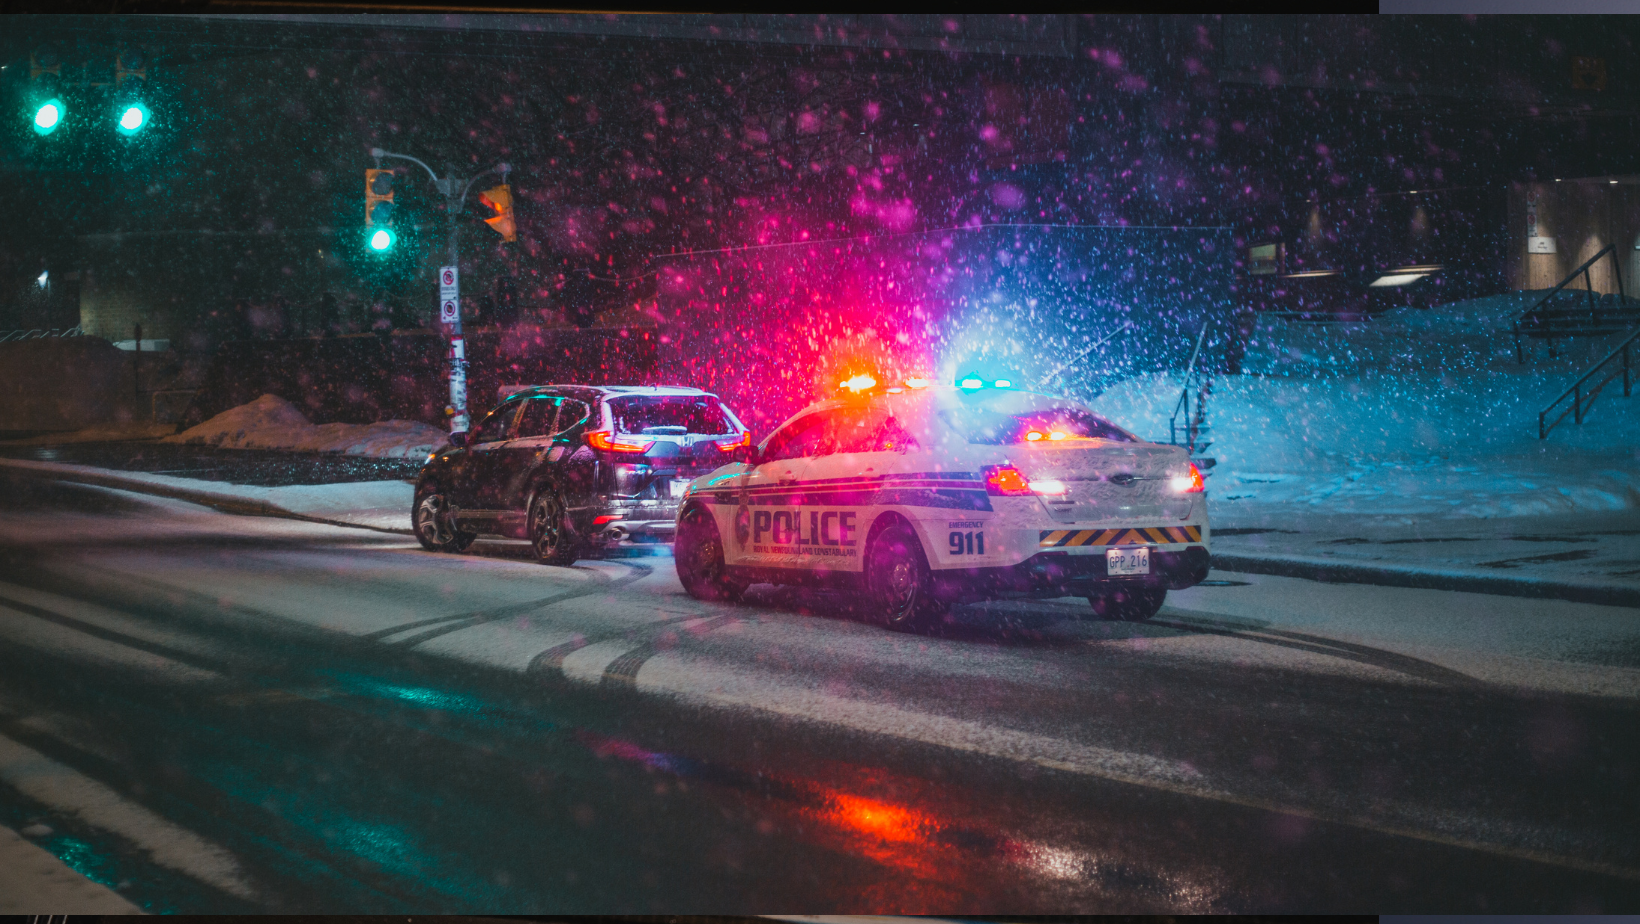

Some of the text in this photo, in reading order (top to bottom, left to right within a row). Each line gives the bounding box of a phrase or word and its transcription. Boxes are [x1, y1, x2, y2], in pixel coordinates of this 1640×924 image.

[753, 510, 857, 546] POLICE
[753, 545, 770, 553] ROYAL
[814, 547, 857, 557] CONSTABULARY
[949, 531, 984, 555] 911
[1110, 555, 1147, 568] GPP 216
